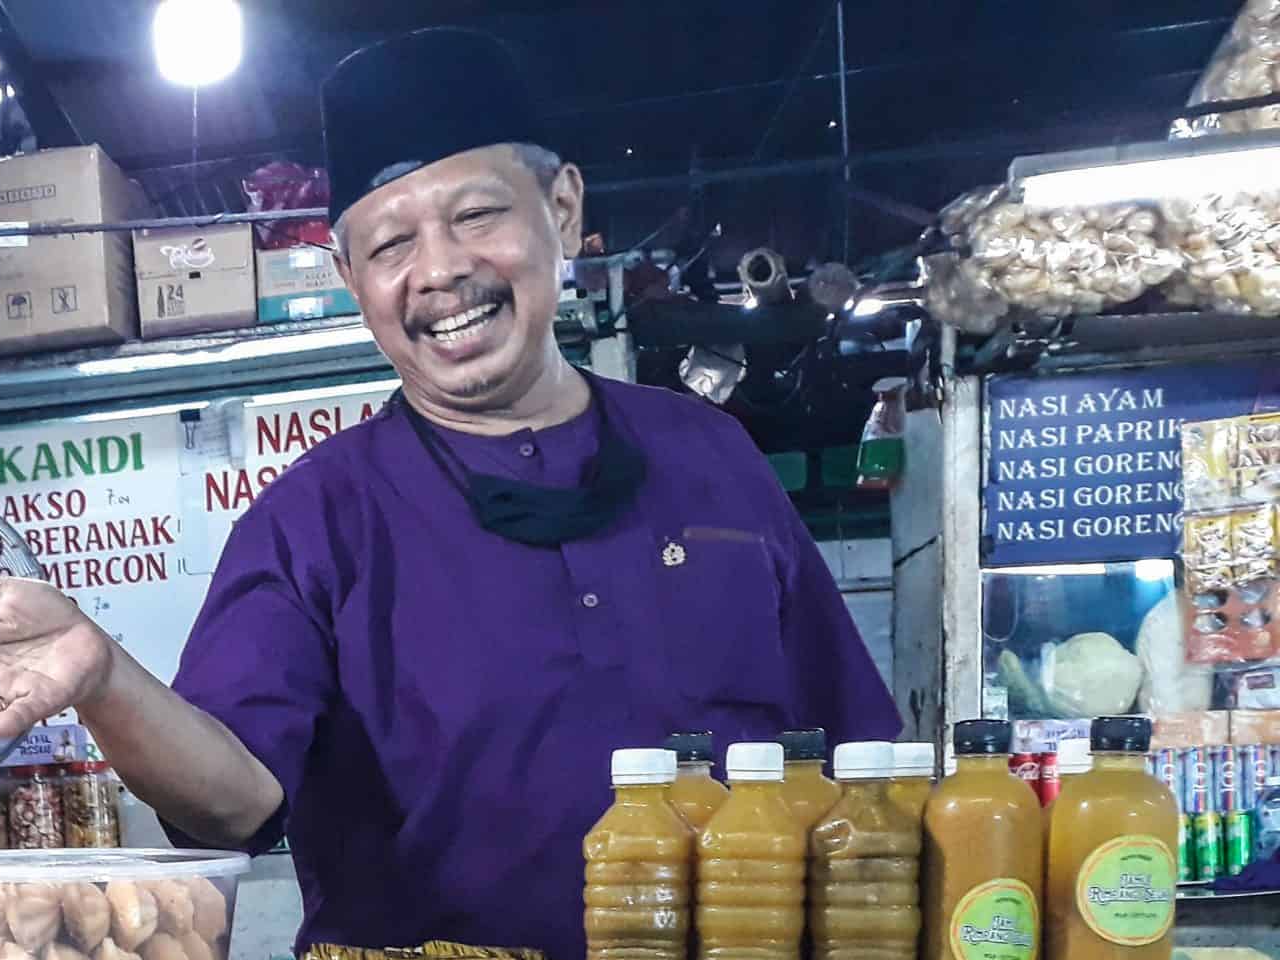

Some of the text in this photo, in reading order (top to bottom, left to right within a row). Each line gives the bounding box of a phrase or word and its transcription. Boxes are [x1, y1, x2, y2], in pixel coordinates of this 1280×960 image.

[999, 388, 1163, 419] NASI AYAM
[256, 406, 342, 455] NASI
[999, 426, 1067, 450] NASI
[997, 457, 1066, 481] NASI
[997, 487, 1065, 512] NASI
[997, 518, 1064, 541] NASI
